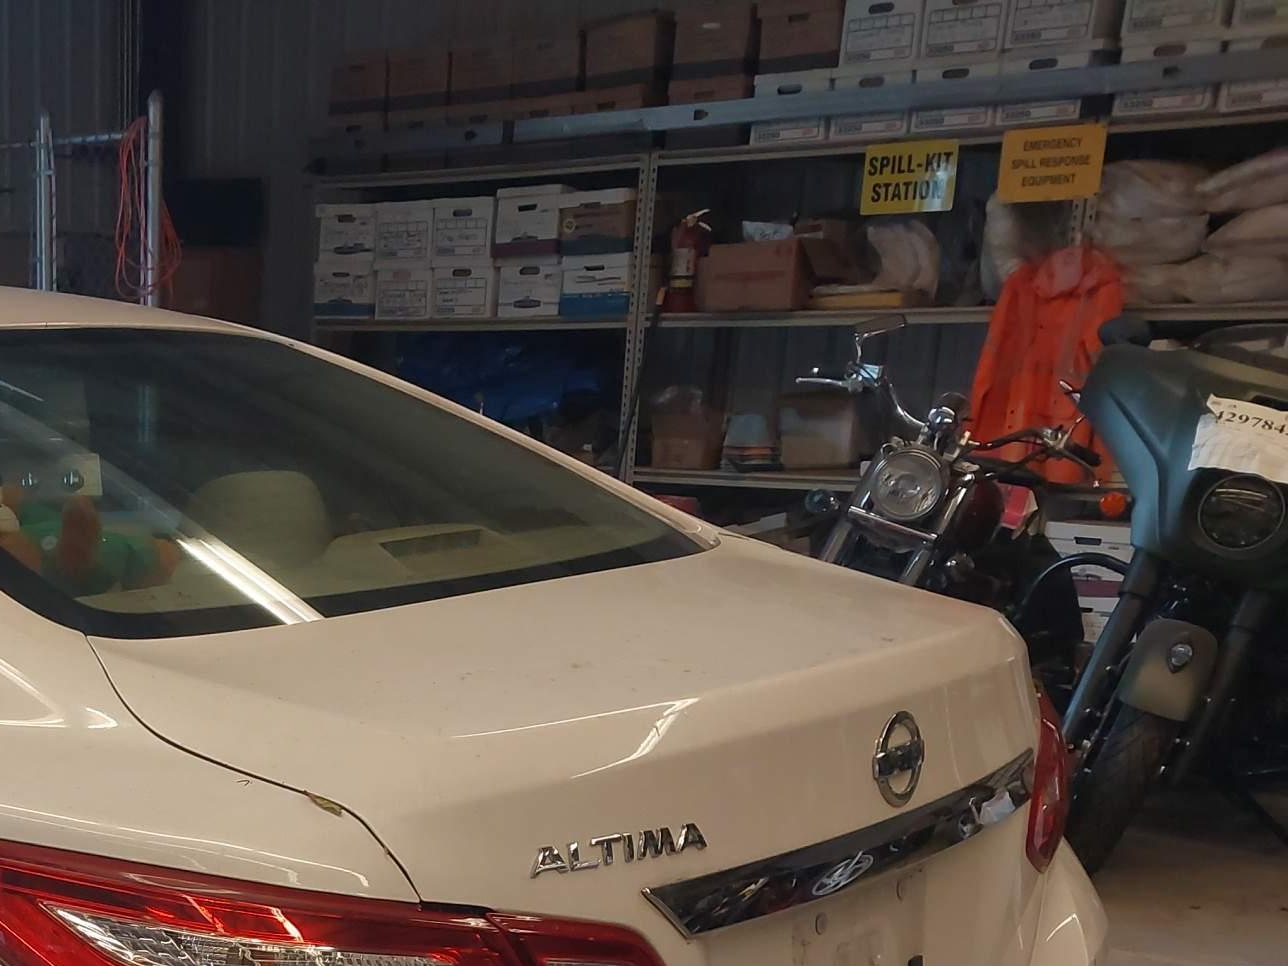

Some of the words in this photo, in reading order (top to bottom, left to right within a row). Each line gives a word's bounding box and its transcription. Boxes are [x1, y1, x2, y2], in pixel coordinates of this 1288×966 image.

[1023, 137, 1082, 151] EMERGENCY
[868, 151, 954, 176] SPILL-KIT
[1011, 158, 1037, 169] SPILL
[1039, 154, 1091, 168] RESPONSE
[871, 179, 943, 203] STATION
[1021, 173, 1076, 187] EQUIPMENT
[1214, 410, 1288, 436] 429784
[529, 822, 708, 878] ALTIMA
